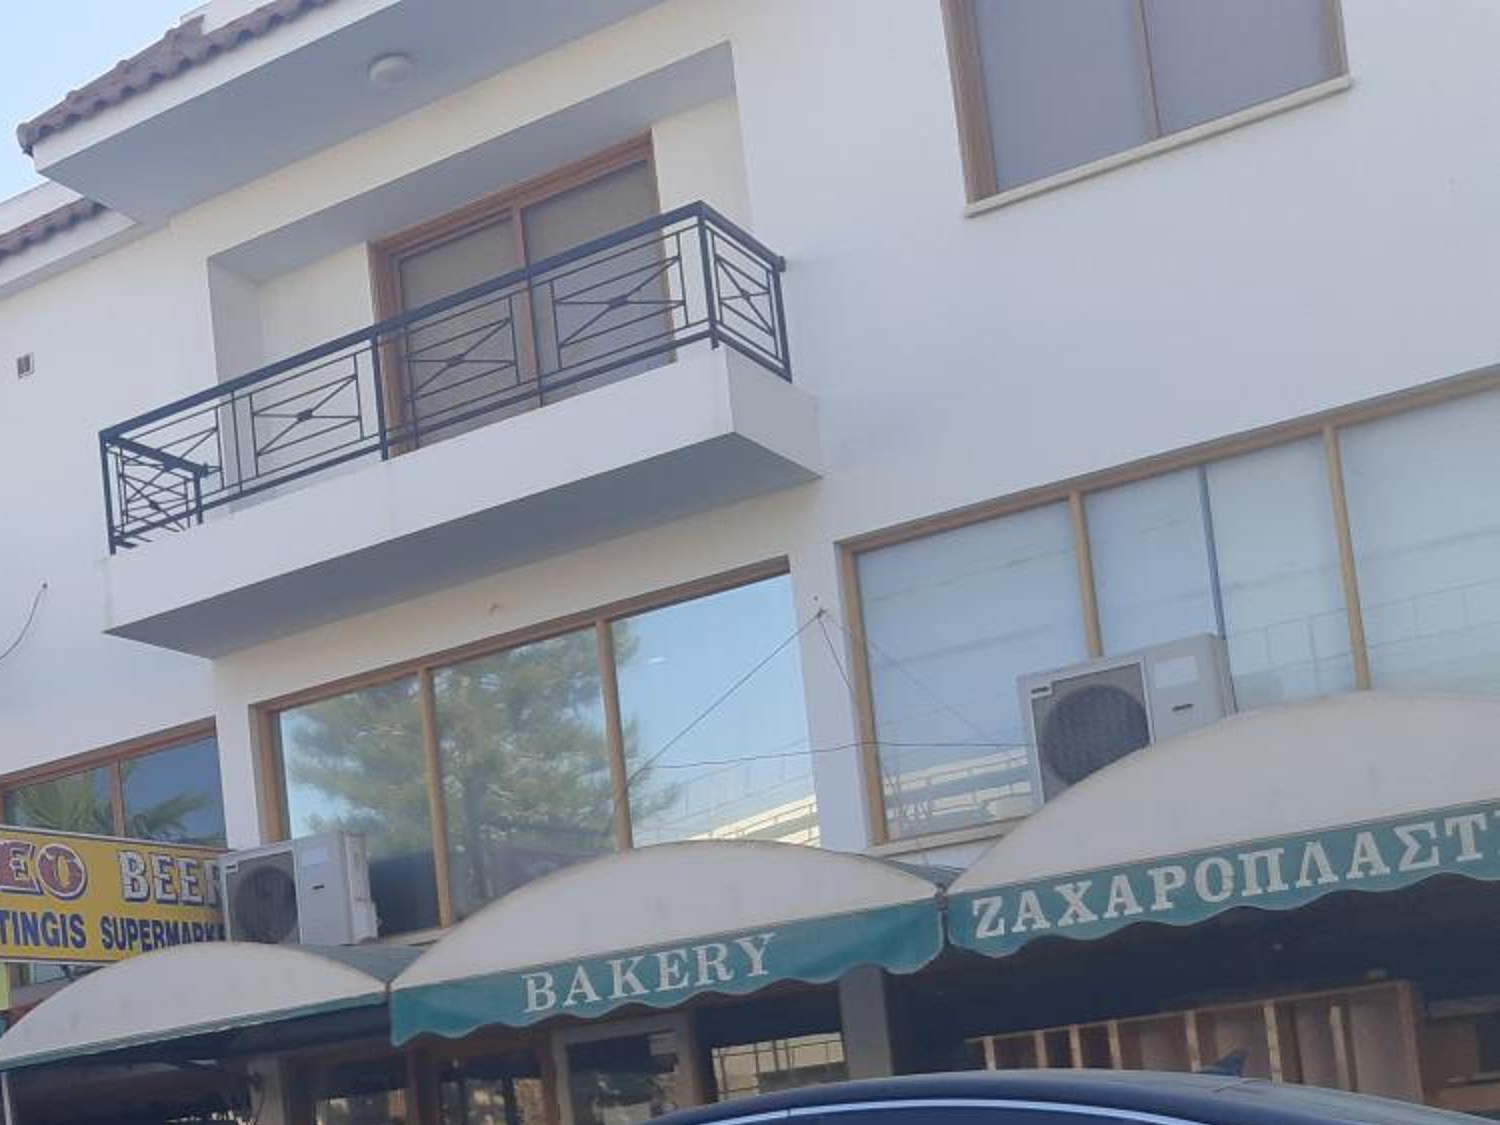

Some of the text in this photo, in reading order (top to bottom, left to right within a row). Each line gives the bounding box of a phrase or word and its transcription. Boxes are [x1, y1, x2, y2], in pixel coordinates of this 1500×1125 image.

[972, 810, 1500, 939] ΖΑΧΑΡΟΠΛΑΣΤ
[100, 916, 226, 952] SUPERMARK
[521, 932, 776, 1013] BAKERY
